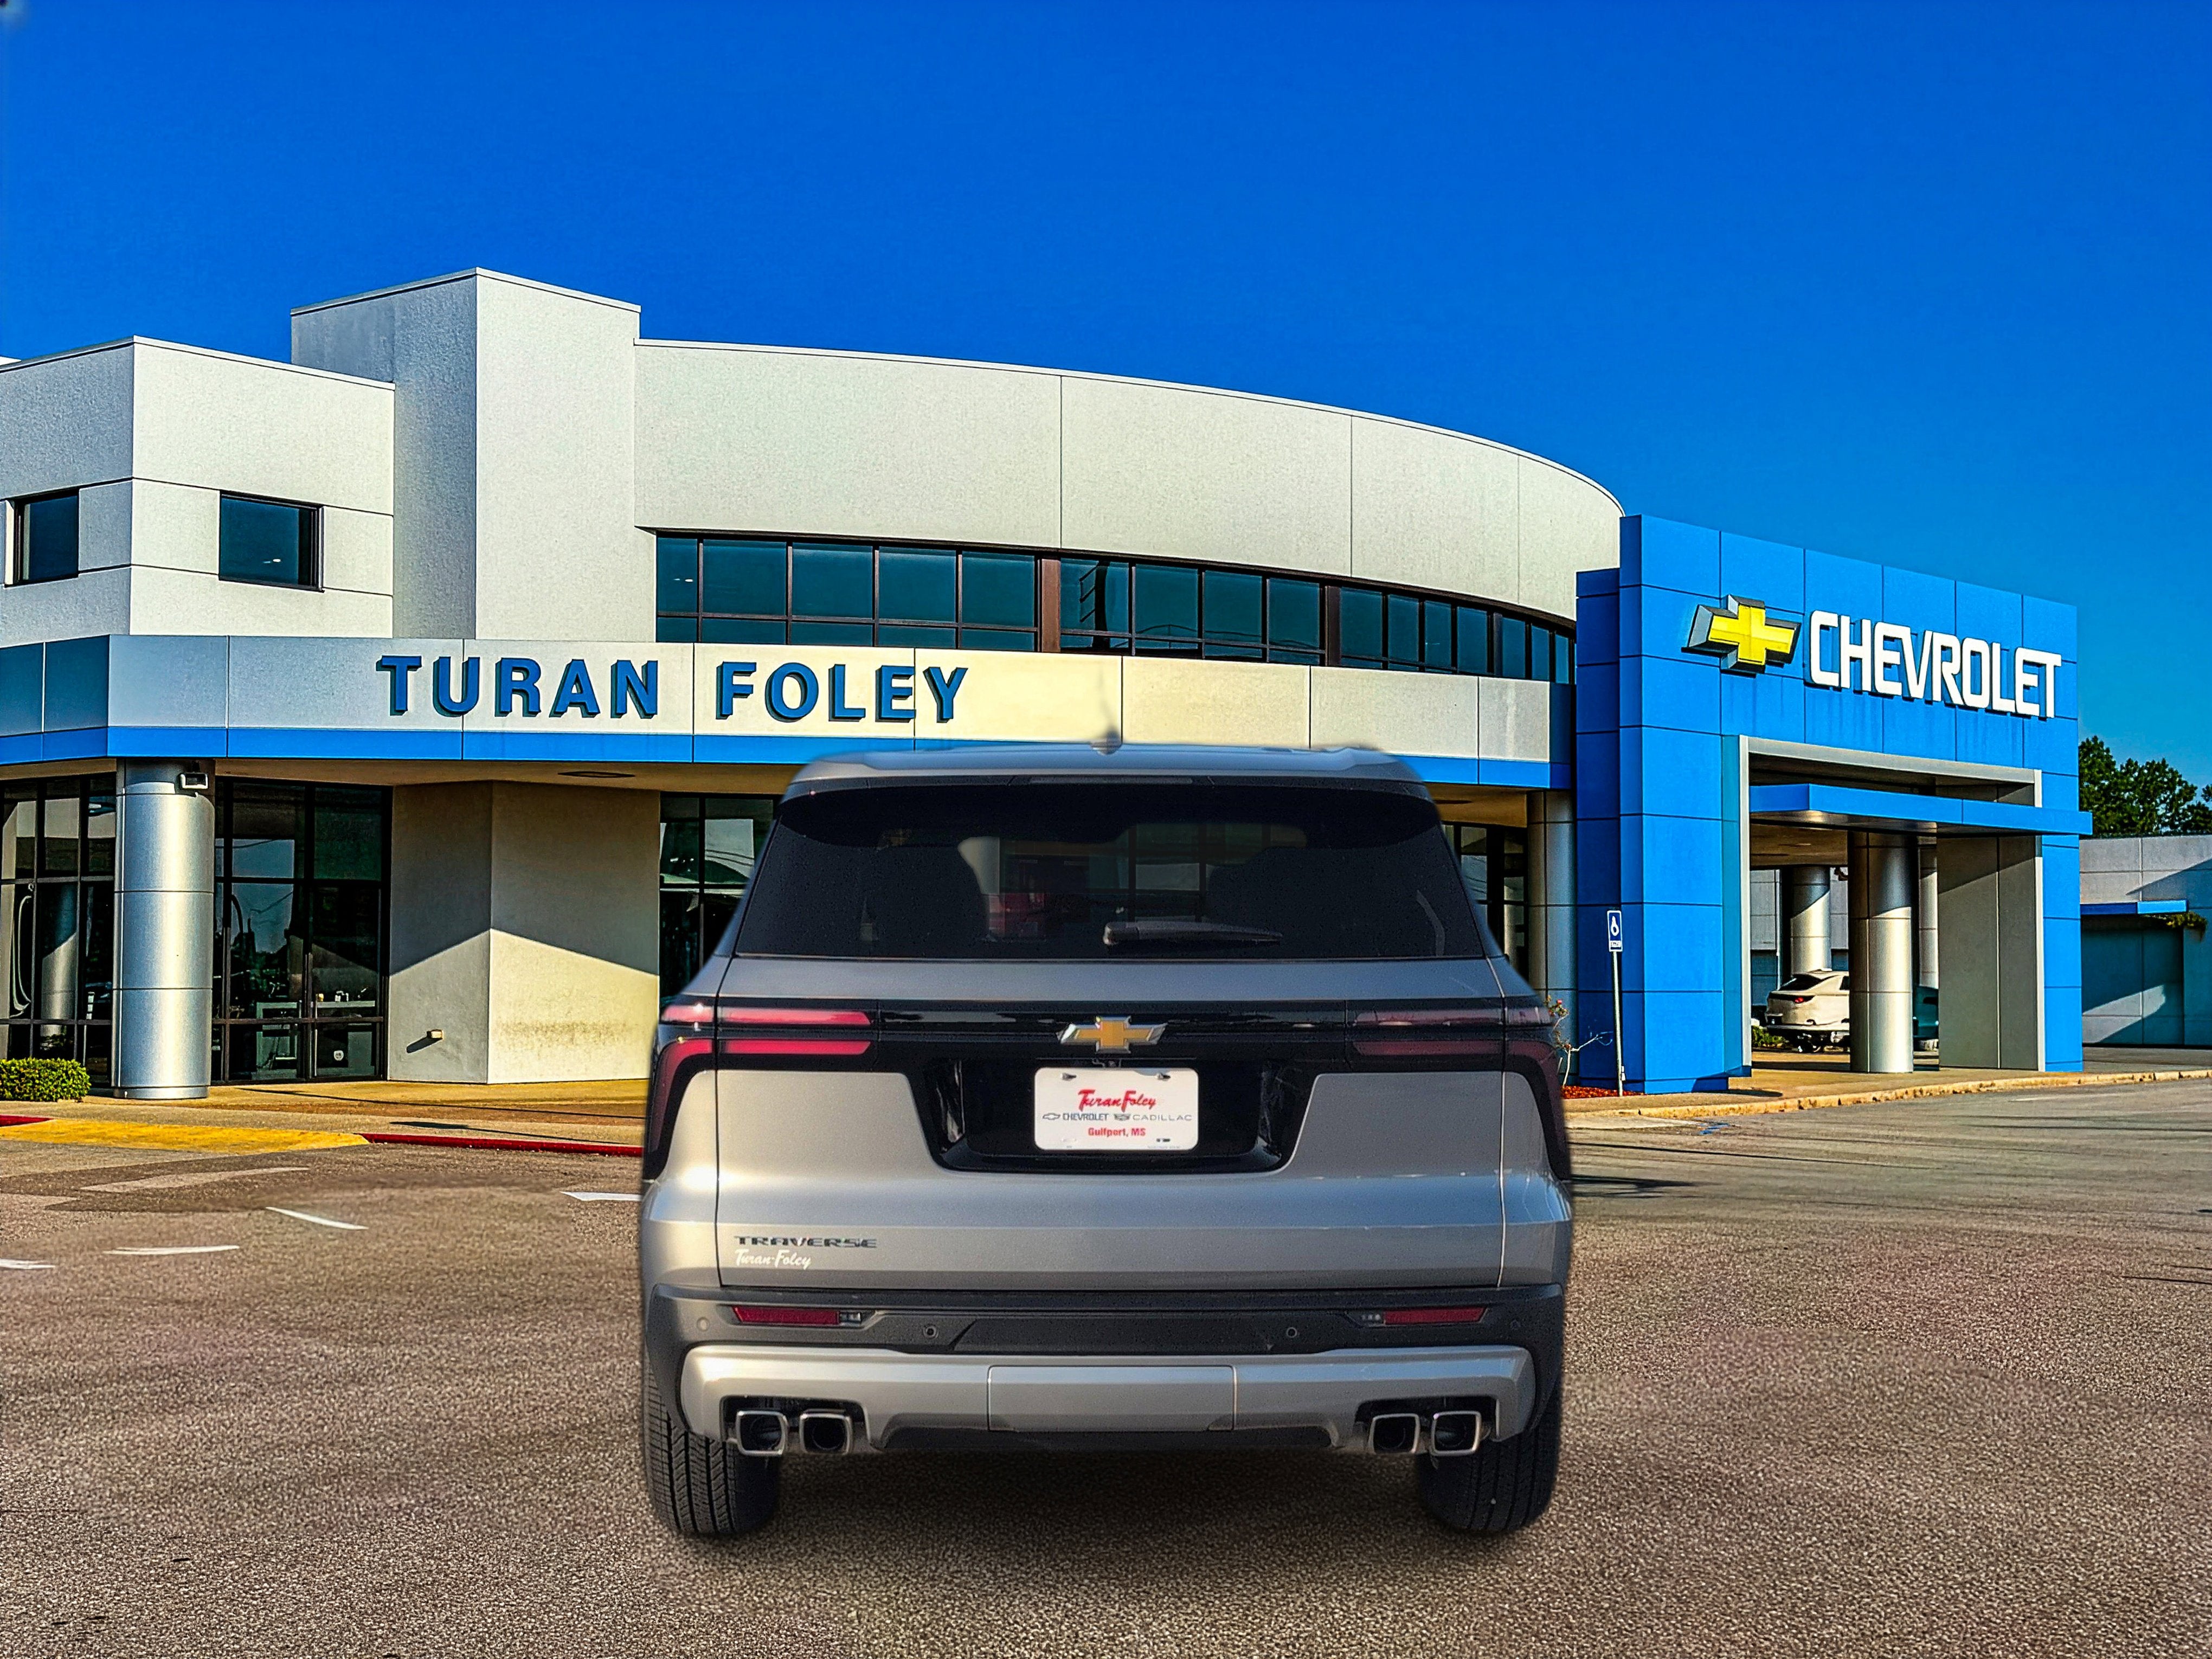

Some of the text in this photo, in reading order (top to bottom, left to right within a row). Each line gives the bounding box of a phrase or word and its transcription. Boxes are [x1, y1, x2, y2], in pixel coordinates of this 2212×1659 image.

[1809, 609, 2062, 719] CHEVROLET
[376, 655, 969, 723] TURAN FOLEY
[1078, 1089, 1156, 1113] Turan Foley
[1062, 1113, 1109, 1121] CHEVROLET
[1088, 1127, 1146, 1137] Gulfport, MS
[734, 1236, 877, 1248] TRAVERSE
[735, 1249, 812, 1270] Turan Foley
